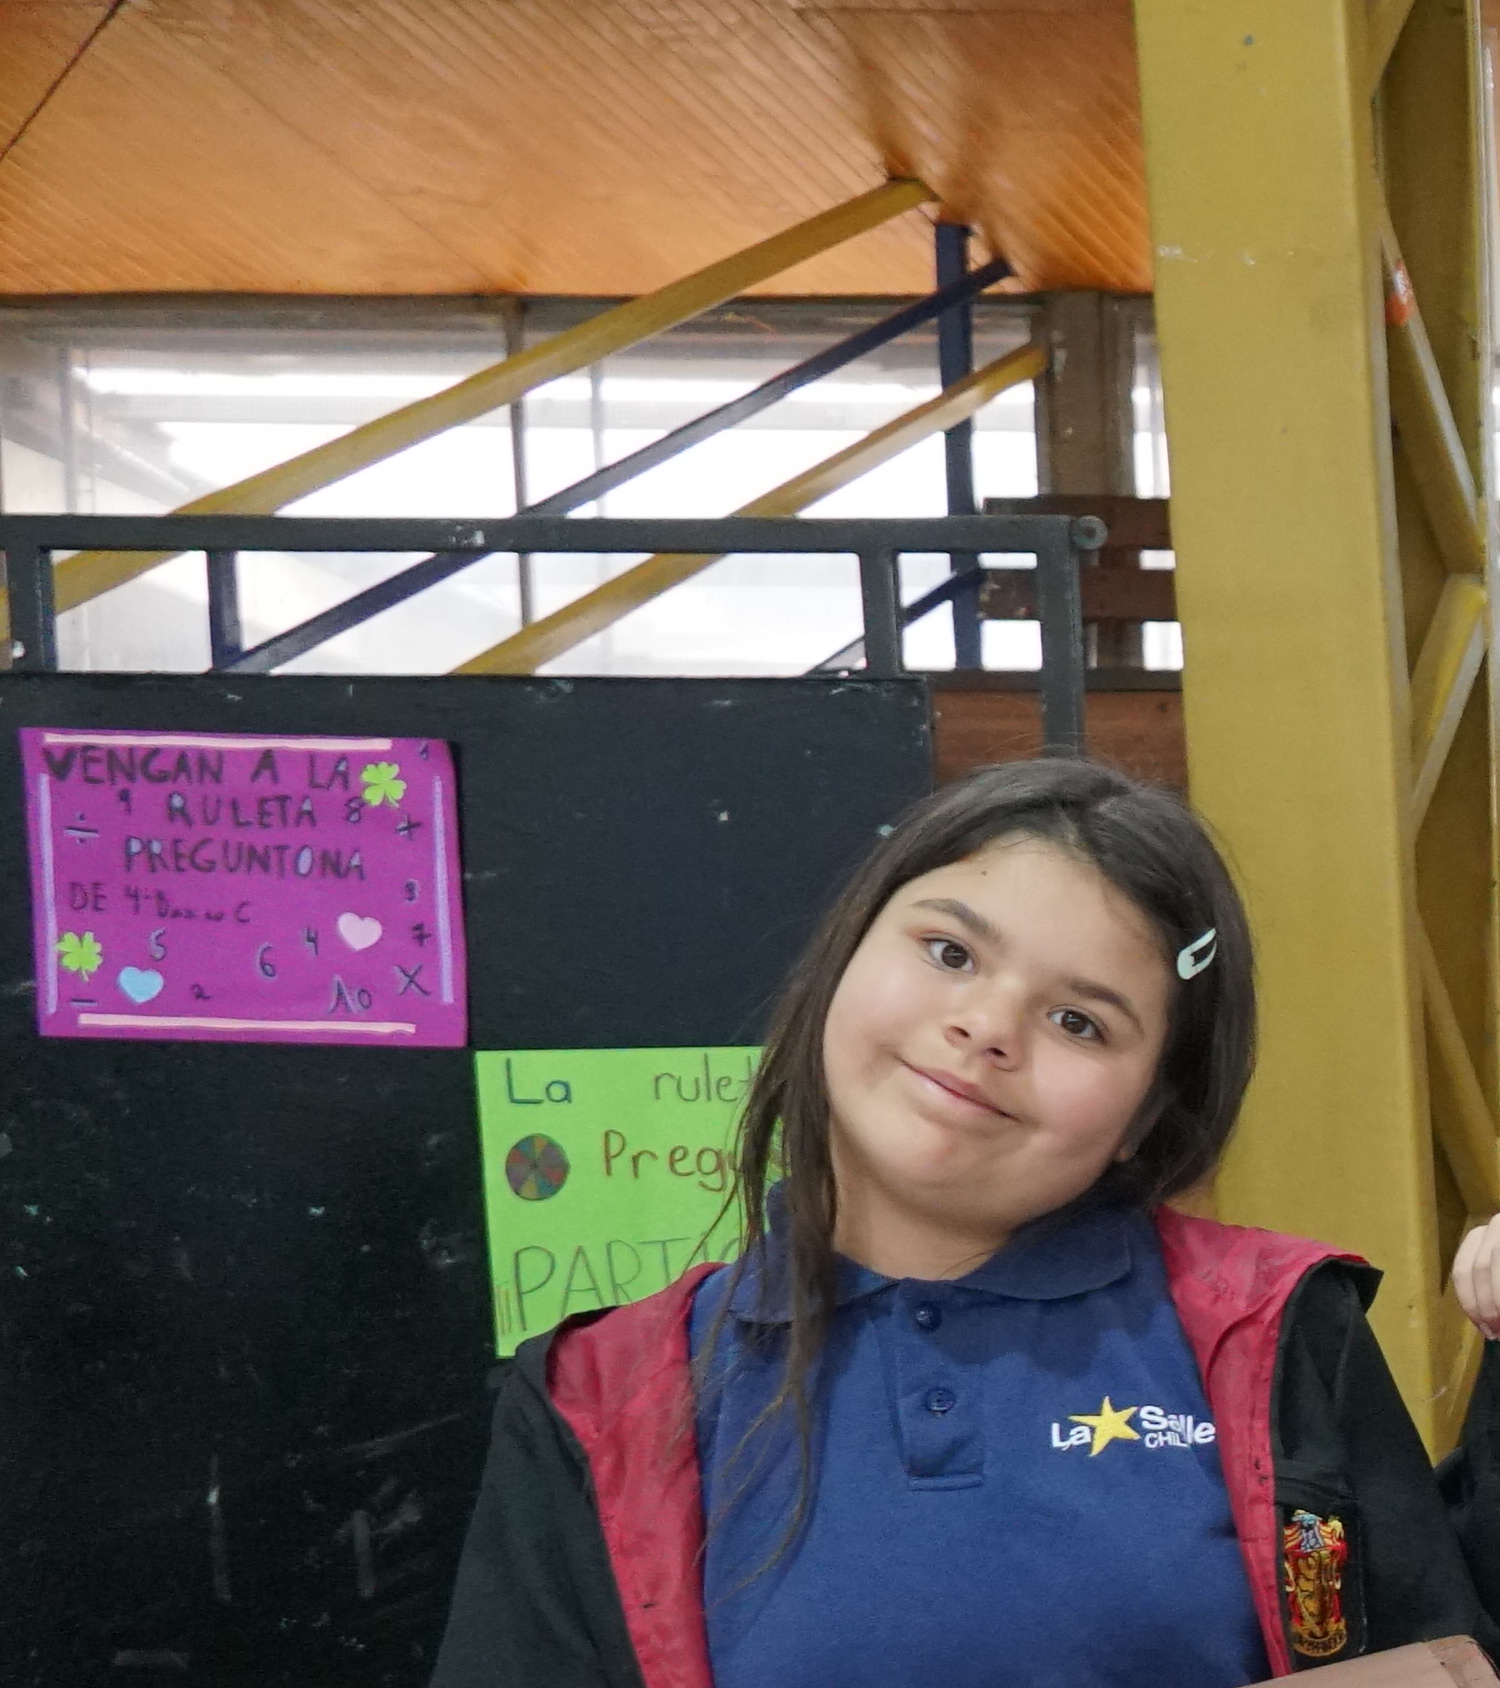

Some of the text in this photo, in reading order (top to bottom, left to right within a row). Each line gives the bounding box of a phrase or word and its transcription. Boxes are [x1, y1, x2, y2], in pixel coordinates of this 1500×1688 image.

[42, 747, 350, 792] VENGAN A LA
[166, 792, 317, 828] RULETA
[123, 836, 367, 882] PREGUNTONA
[68, 881, 107, 913] DE
[256, 945, 278, 980] 6
[505, 1052, 754, 1105] La rulet
[602, 1129, 738, 1193] Preg
[1051, 1405, 1216, 1451] La Salle
